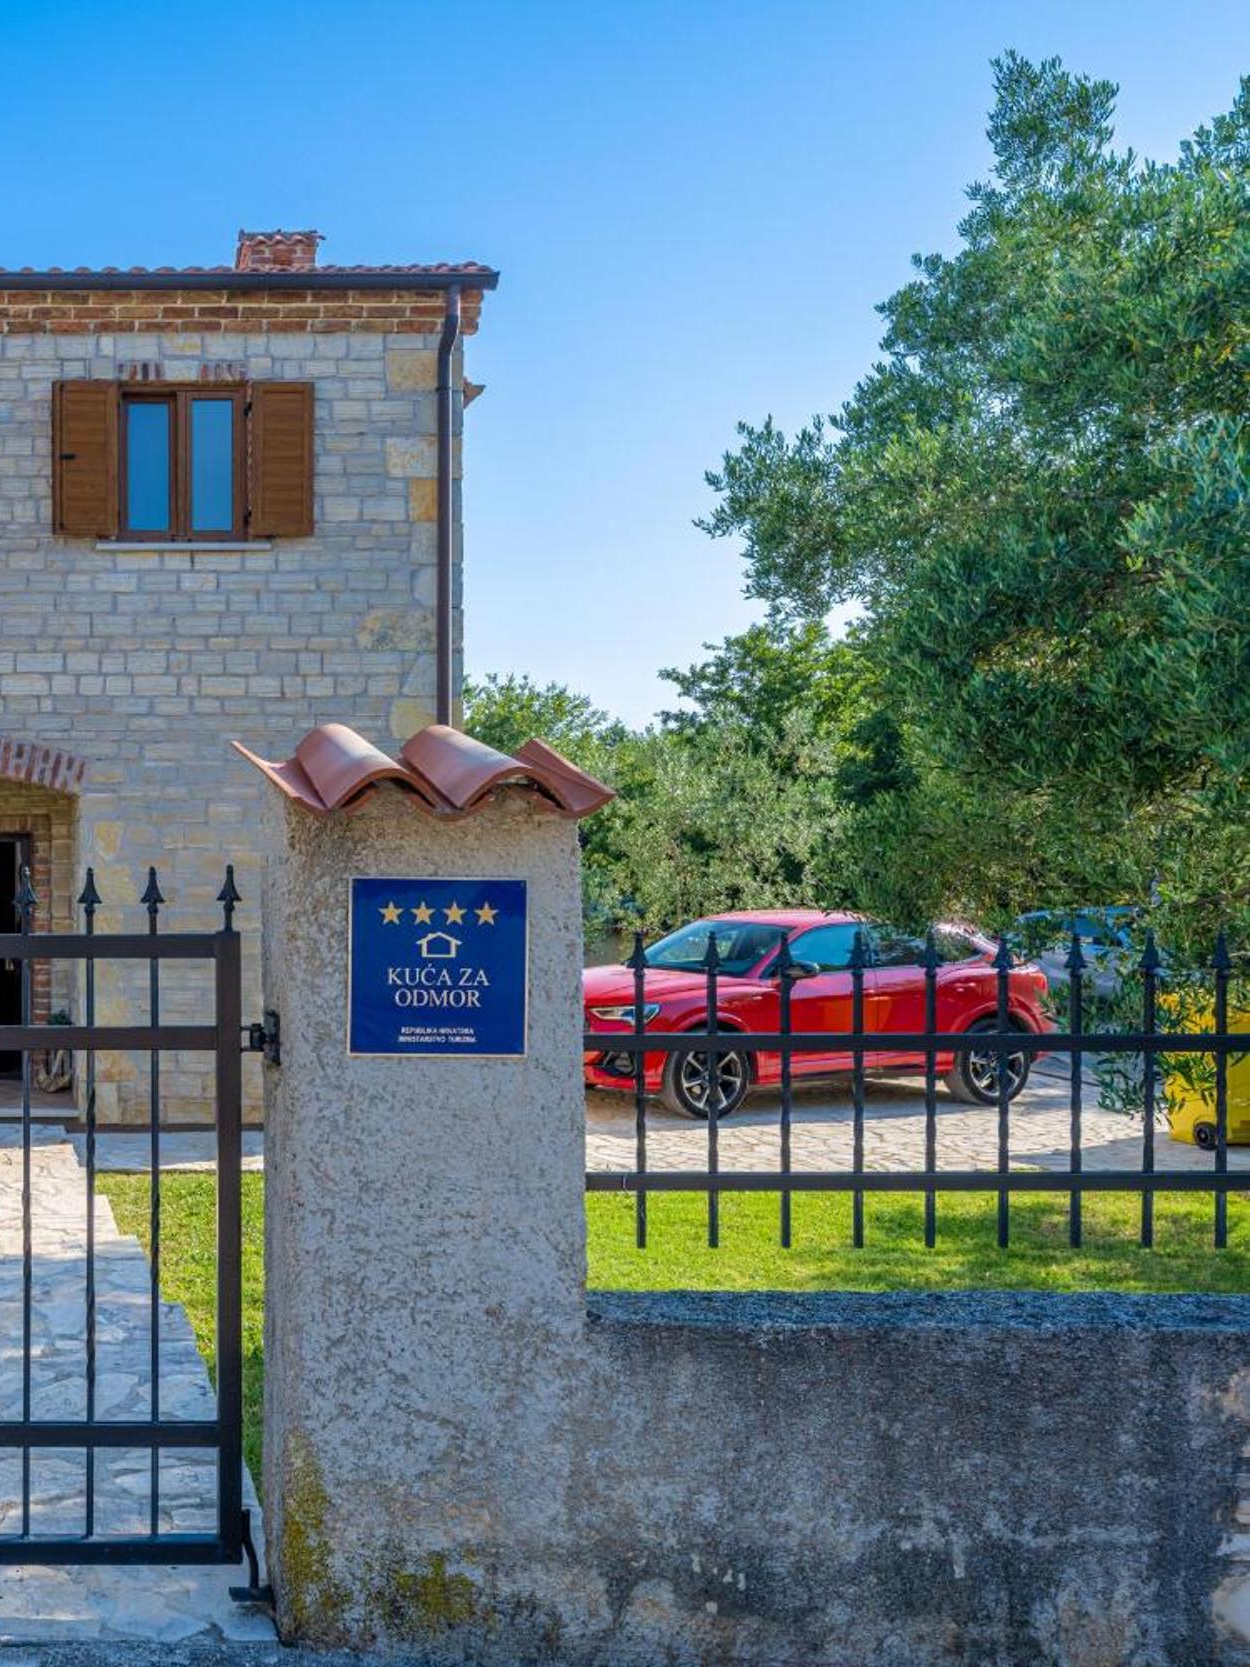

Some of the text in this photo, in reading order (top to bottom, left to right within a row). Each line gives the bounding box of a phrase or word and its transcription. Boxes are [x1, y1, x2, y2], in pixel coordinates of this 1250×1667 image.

[388, 963, 491, 986] KUĆA ZA
[395, 988, 481, 1007] ODMOR
